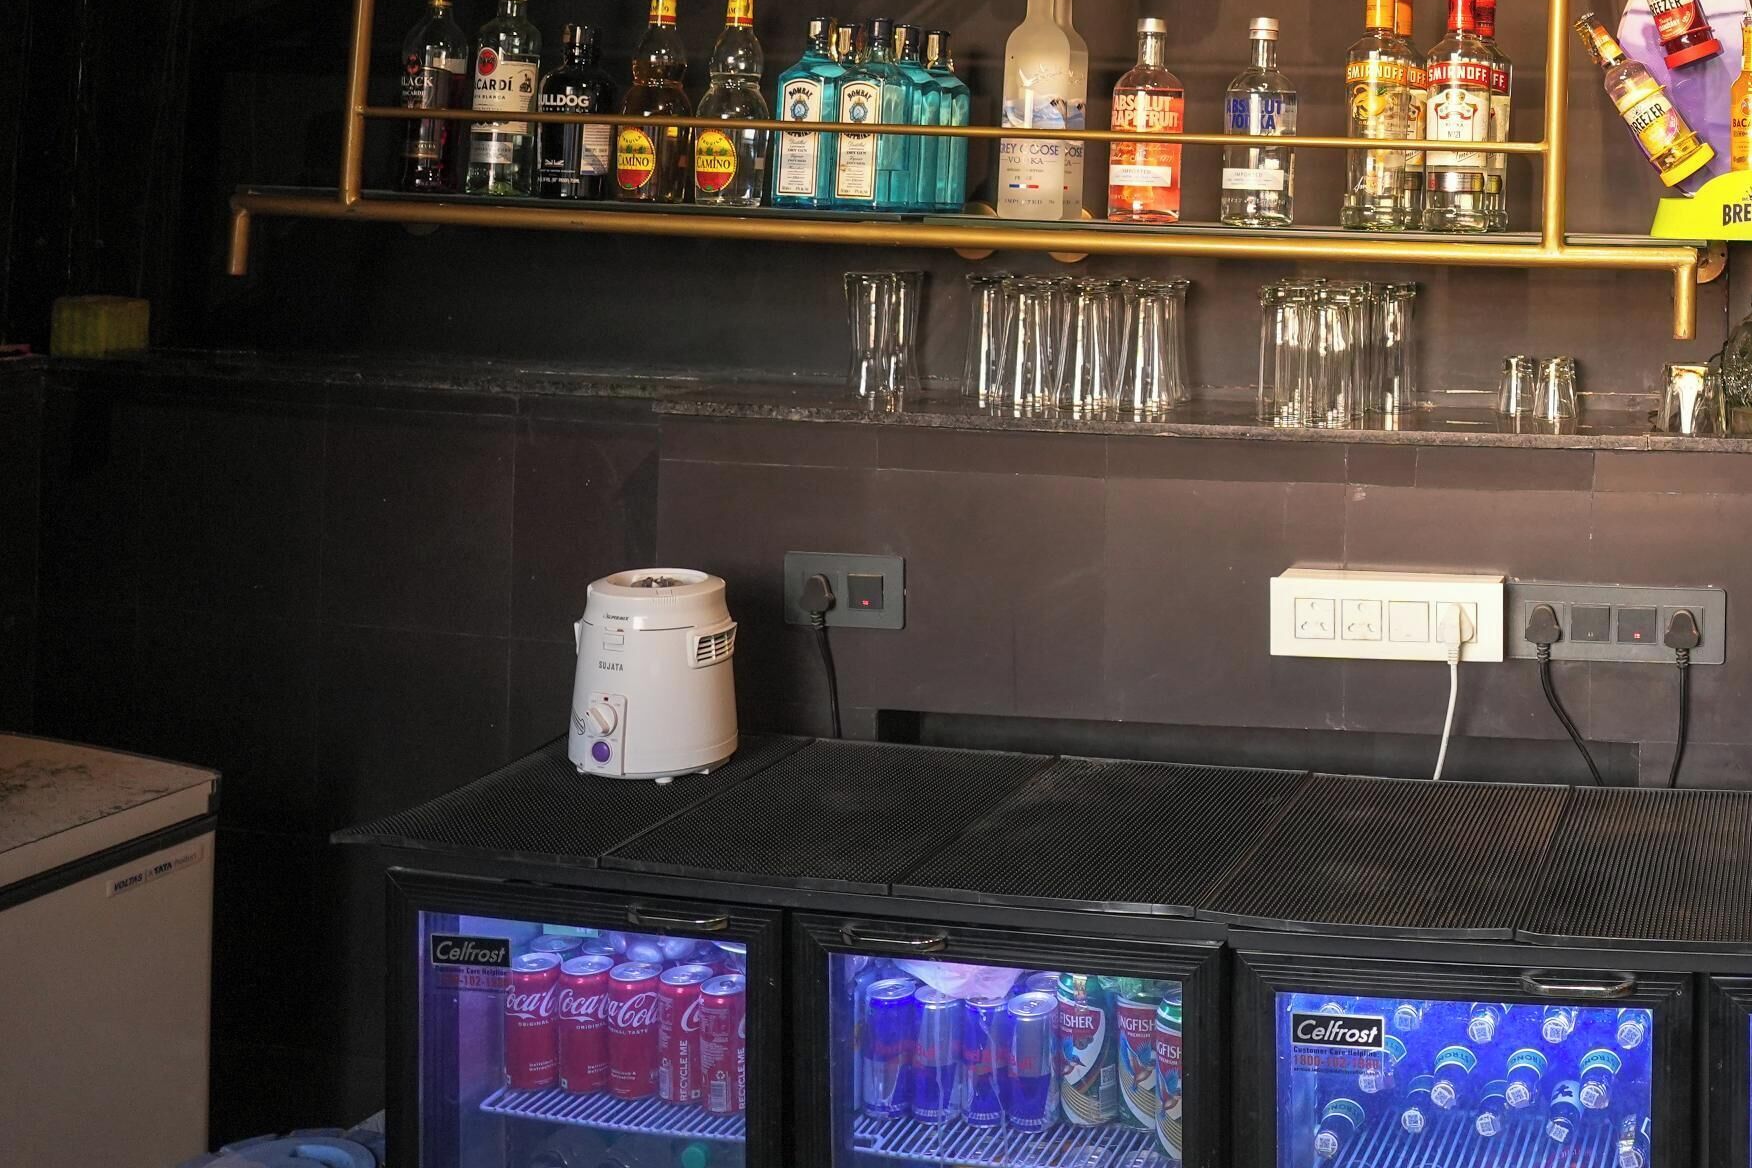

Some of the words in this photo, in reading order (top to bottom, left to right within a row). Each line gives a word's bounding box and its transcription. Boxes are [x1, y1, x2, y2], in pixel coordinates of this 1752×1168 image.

[538, 94, 590, 108] ULLDOG
[1008, 157, 1044, 167] VOKA
[598, 660, 624, 672] SUJATA
[114, 872, 143, 892] VOLTAS
[154, 861, 173, 876] TATA
[436, 940, 506, 964] Celfrost
[1060, 1014, 1094, 1031] FISHER
[1118, 1017, 1156, 1033] INGFISH
[1296, 1019, 1379, 1044] Celfrost
[679, 1039, 688, 1054] ME
[1437, 1049, 1473, 1066] STRON
[1583, 1053, 1617, 1067] STRON
[679, 1056, 689, 1102] RECYCLE
